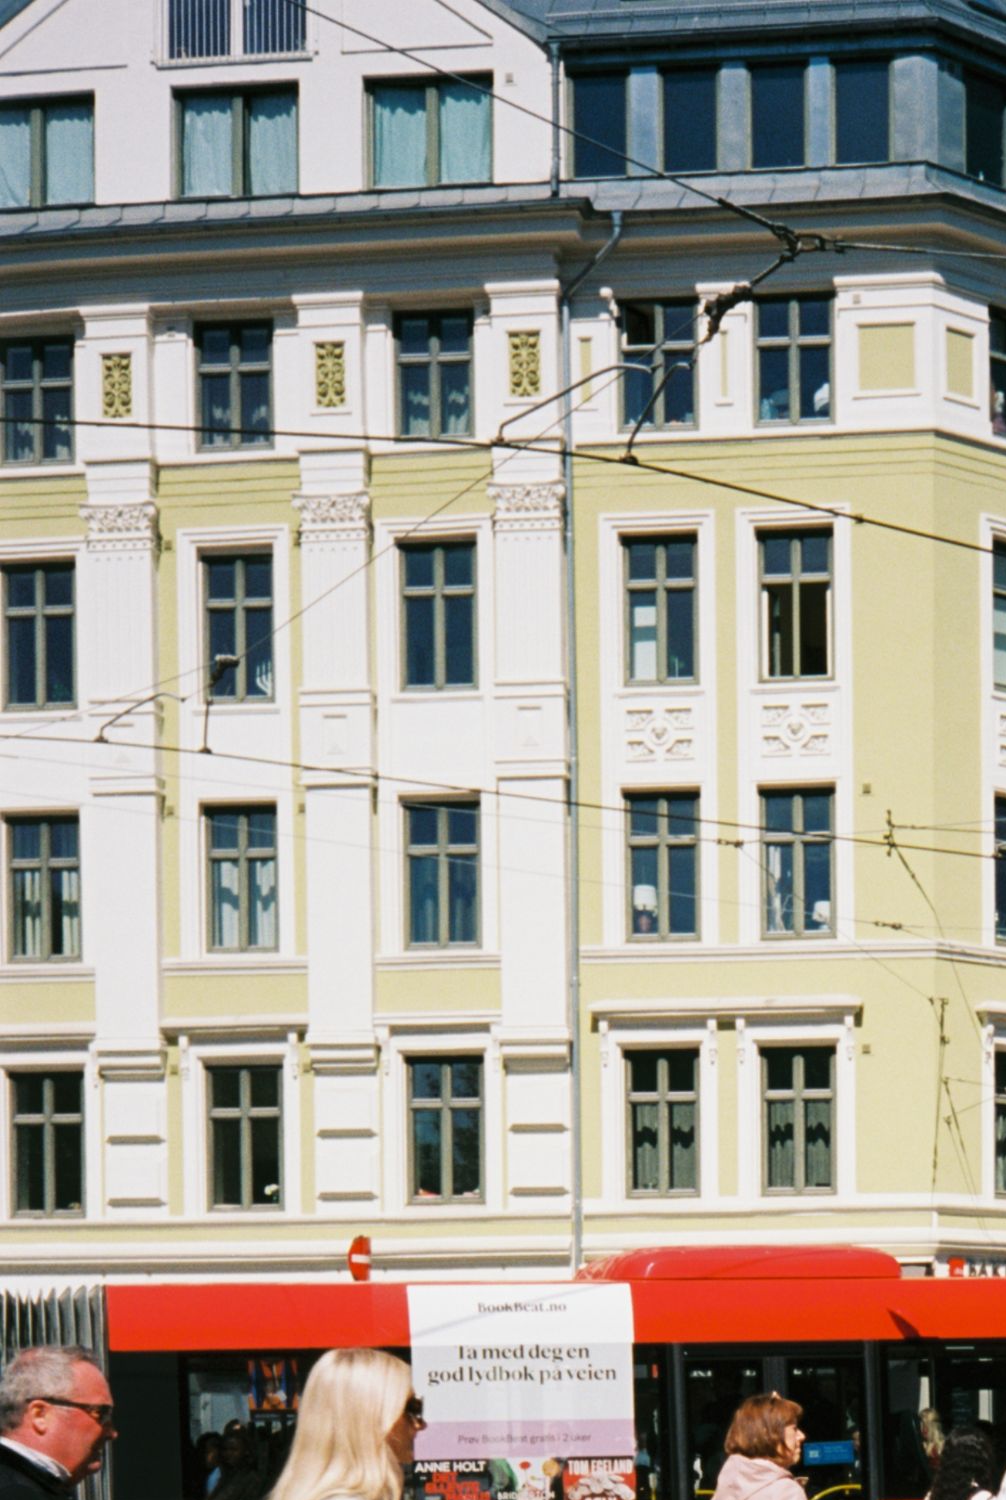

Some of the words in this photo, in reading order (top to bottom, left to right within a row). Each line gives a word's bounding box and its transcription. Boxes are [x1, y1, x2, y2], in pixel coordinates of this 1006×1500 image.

[477, 1302, 567, 1313] BookBeat.no
[458, 1345, 478, 1360] Ta
[482, 1344, 525, 1360] med
[528, 1344, 564, 1362] deg
[566, 1346, 590, 1359] en
[428, 1366, 464, 1386] god
[468, 1365, 534, 1385] lydbok
[539, 1363, 562, 1385] på
[565, 1363, 617, 1381] veien
[414, 1461, 451, 1473] ANNE
[452, 1460, 486, 1473] HOLT
[567, 1460, 589, 1475] TOM
